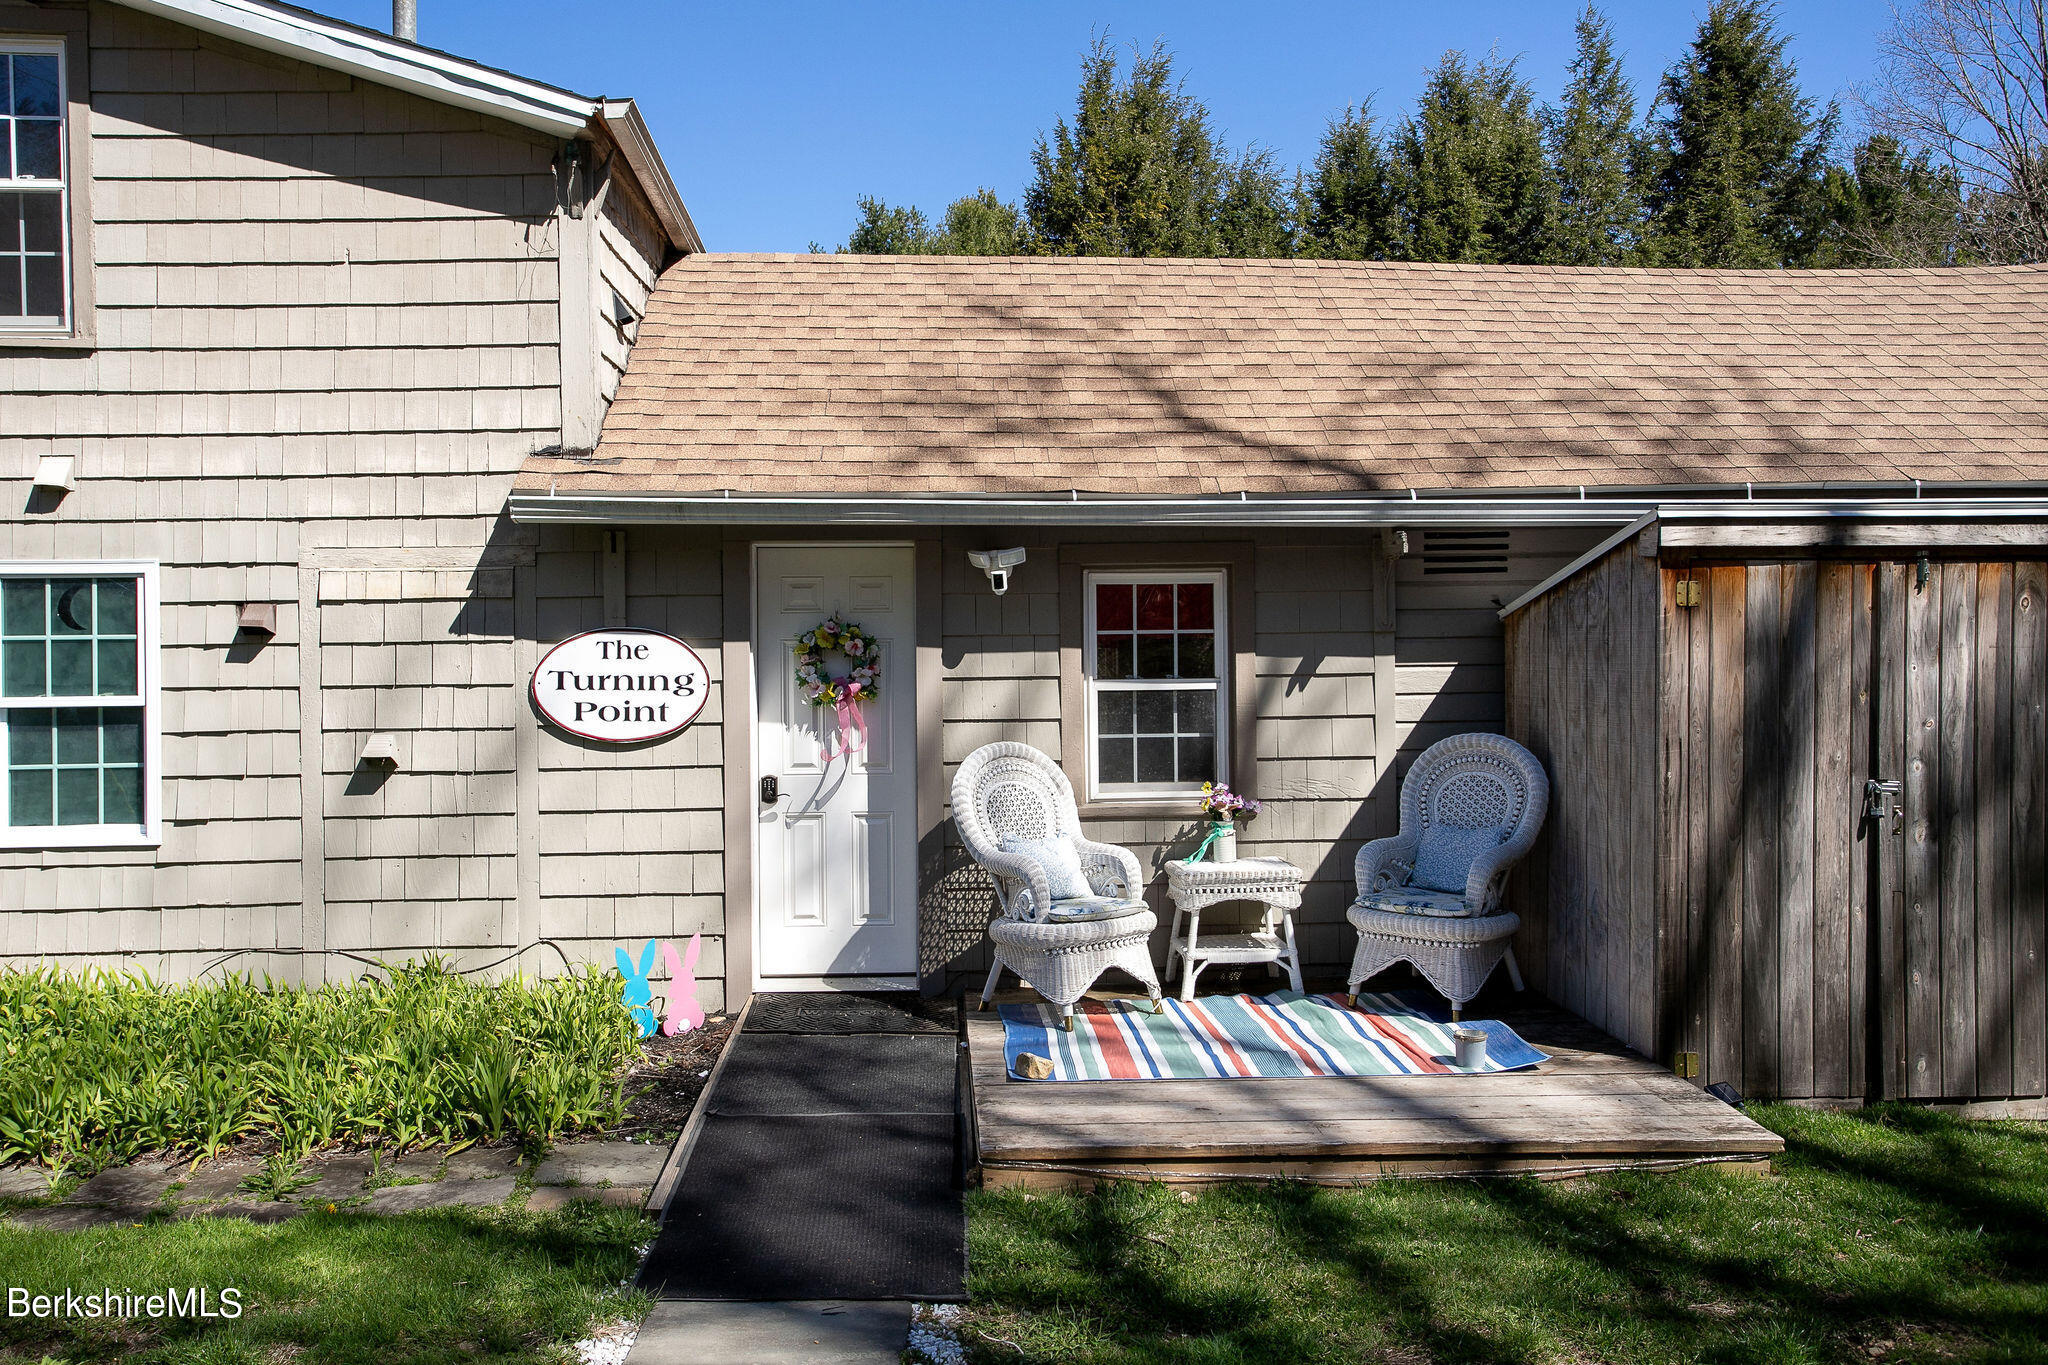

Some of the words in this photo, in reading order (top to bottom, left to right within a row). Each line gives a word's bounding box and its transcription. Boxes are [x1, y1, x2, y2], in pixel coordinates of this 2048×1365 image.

[595, 640, 650, 660] The
[547, 670, 695, 697] Turning
[573, 700, 669, 722] Point
